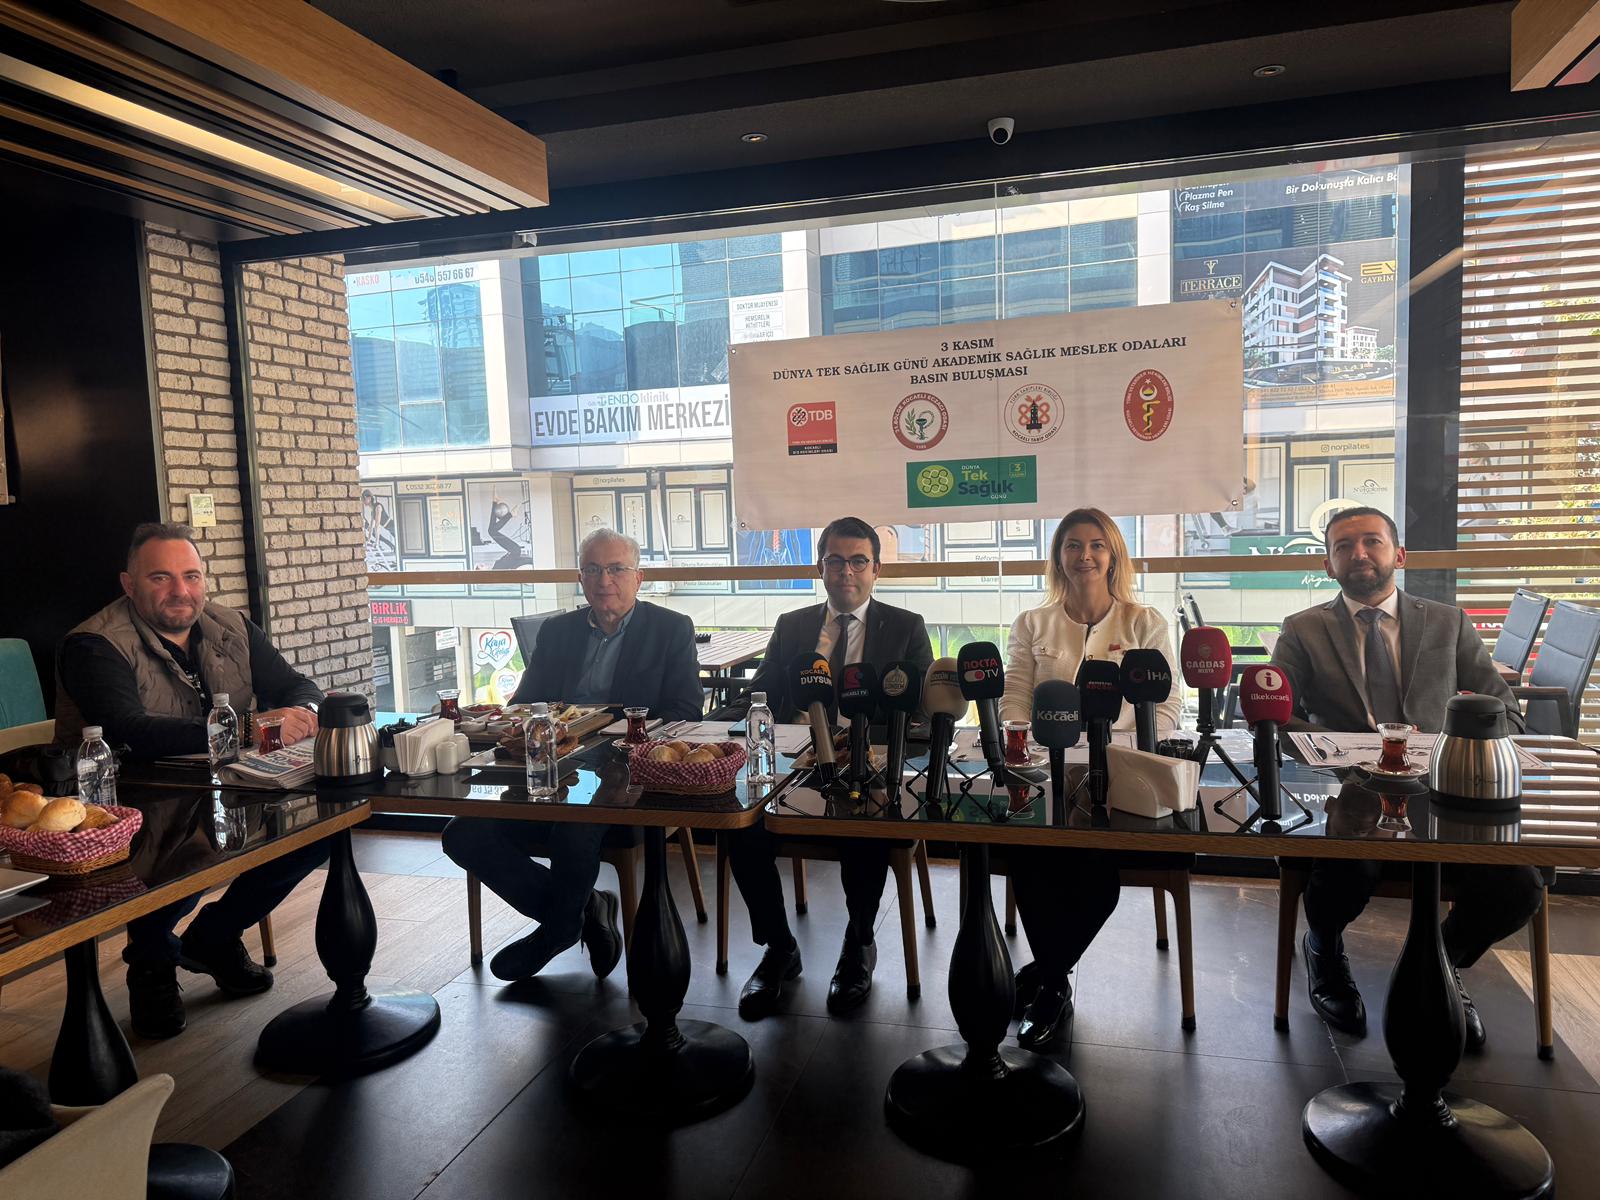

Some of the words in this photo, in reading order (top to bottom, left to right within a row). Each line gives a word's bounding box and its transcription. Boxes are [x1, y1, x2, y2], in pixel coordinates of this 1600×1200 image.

[1286, 185, 1299, 194] Bir
[1356, 174, 1384, 185] Kalıcı
[1185, 191, 1215, 200] Plazma
[1217, 189, 1234, 197] Pen
[1185, 204, 1200, 212] Kaş
[1202, 200, 1224, 210] Silme
[438, 270, 451, 282] 557
[452, 268, 464, 280] 66
[465, 267, 474, 278] 67
[1182, 276, 1240, 292] TERRACE
[940, 343, 948, 352] 3
[952, 338, 994, 350] KASIM
[773, 370, 813, 380] DÜNYA
[816, 366, 840, 378] TEK
[844, 362, 890, 375] SAĞLIK
[894, 356, 928, 370] GÜNÜ
[932, 351, 1002, 368] AKADEMİK
[1006, 348, 1056, 362] SAĞLIK
[1060, 343, 1118, 357] MESLEK
[1122, 336, 1186, 352] ODALARI
[910, 372, 948, 384] BASIN
[952, 366, 1028, 382] BULUŞMASI
[902, 394, 926, 406] KOCAELİ
[927, 394, 945, 411] ECZACI
[534, 409, 579, 436] EVDE
[583, 405, 642, 434] BAKIM
[648, 394, 730, 431] MERKEZİ
[808, 410, 832, 421] TDB
[962, 470, 988, 481] Tek
[958, 480, 1014, 498] Sağlık
[985, 668, 998, 678] TV
[1147, 670, 1170, 681] İHA
[1036, 710, 1079, 722] Kocaeli
